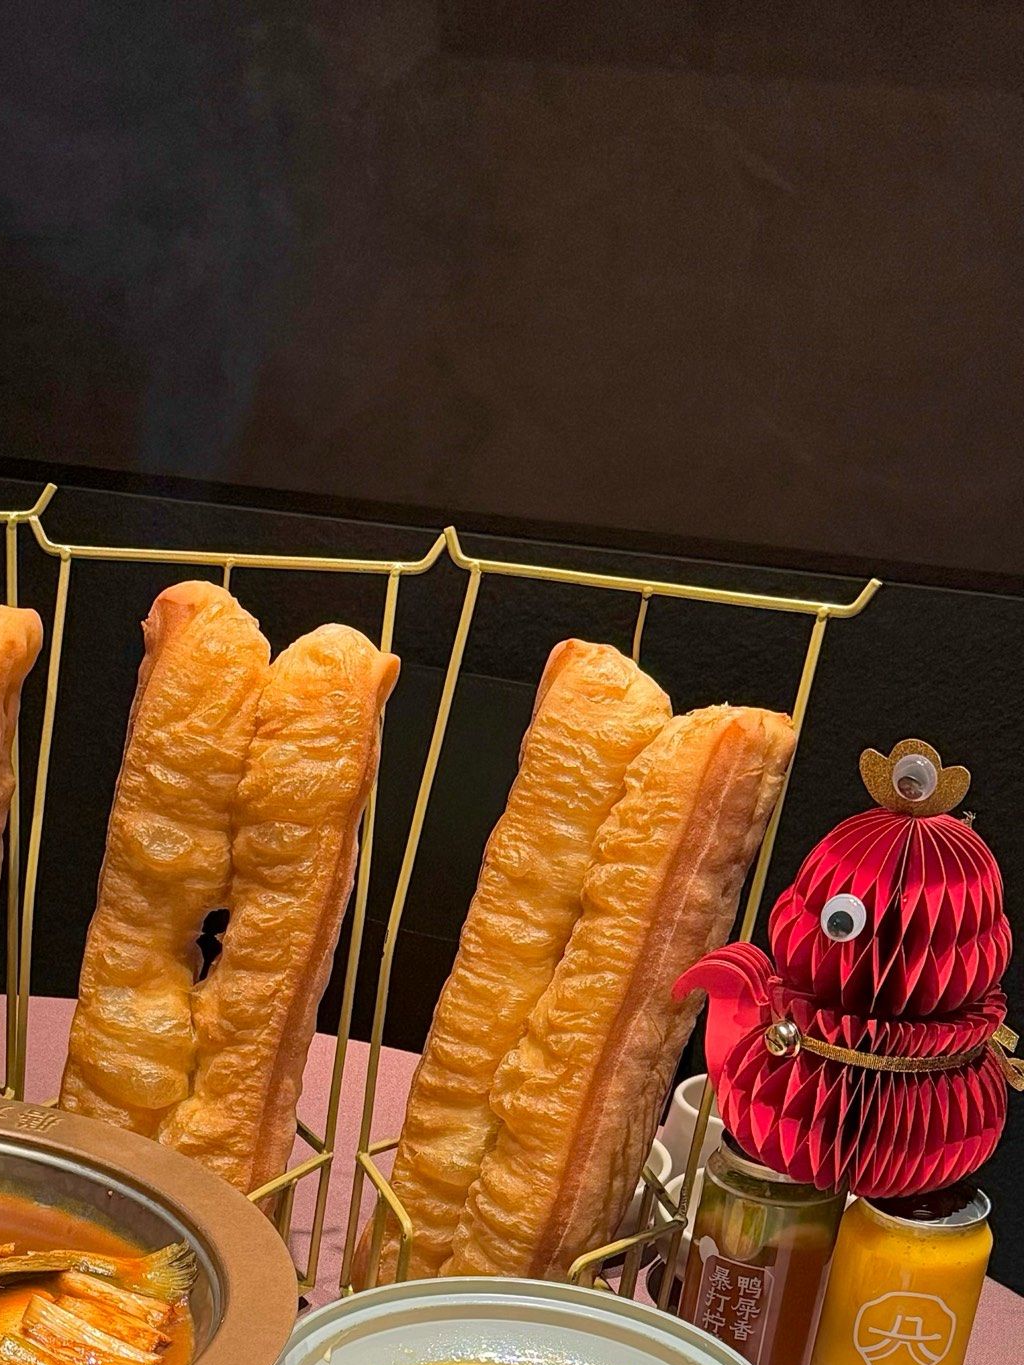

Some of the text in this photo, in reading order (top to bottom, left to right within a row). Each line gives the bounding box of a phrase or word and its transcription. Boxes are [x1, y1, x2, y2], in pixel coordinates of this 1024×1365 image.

[702, 1265, 733, 1341] 暴打柠
[730, 1275, 762, 1341] 鸭屎香
